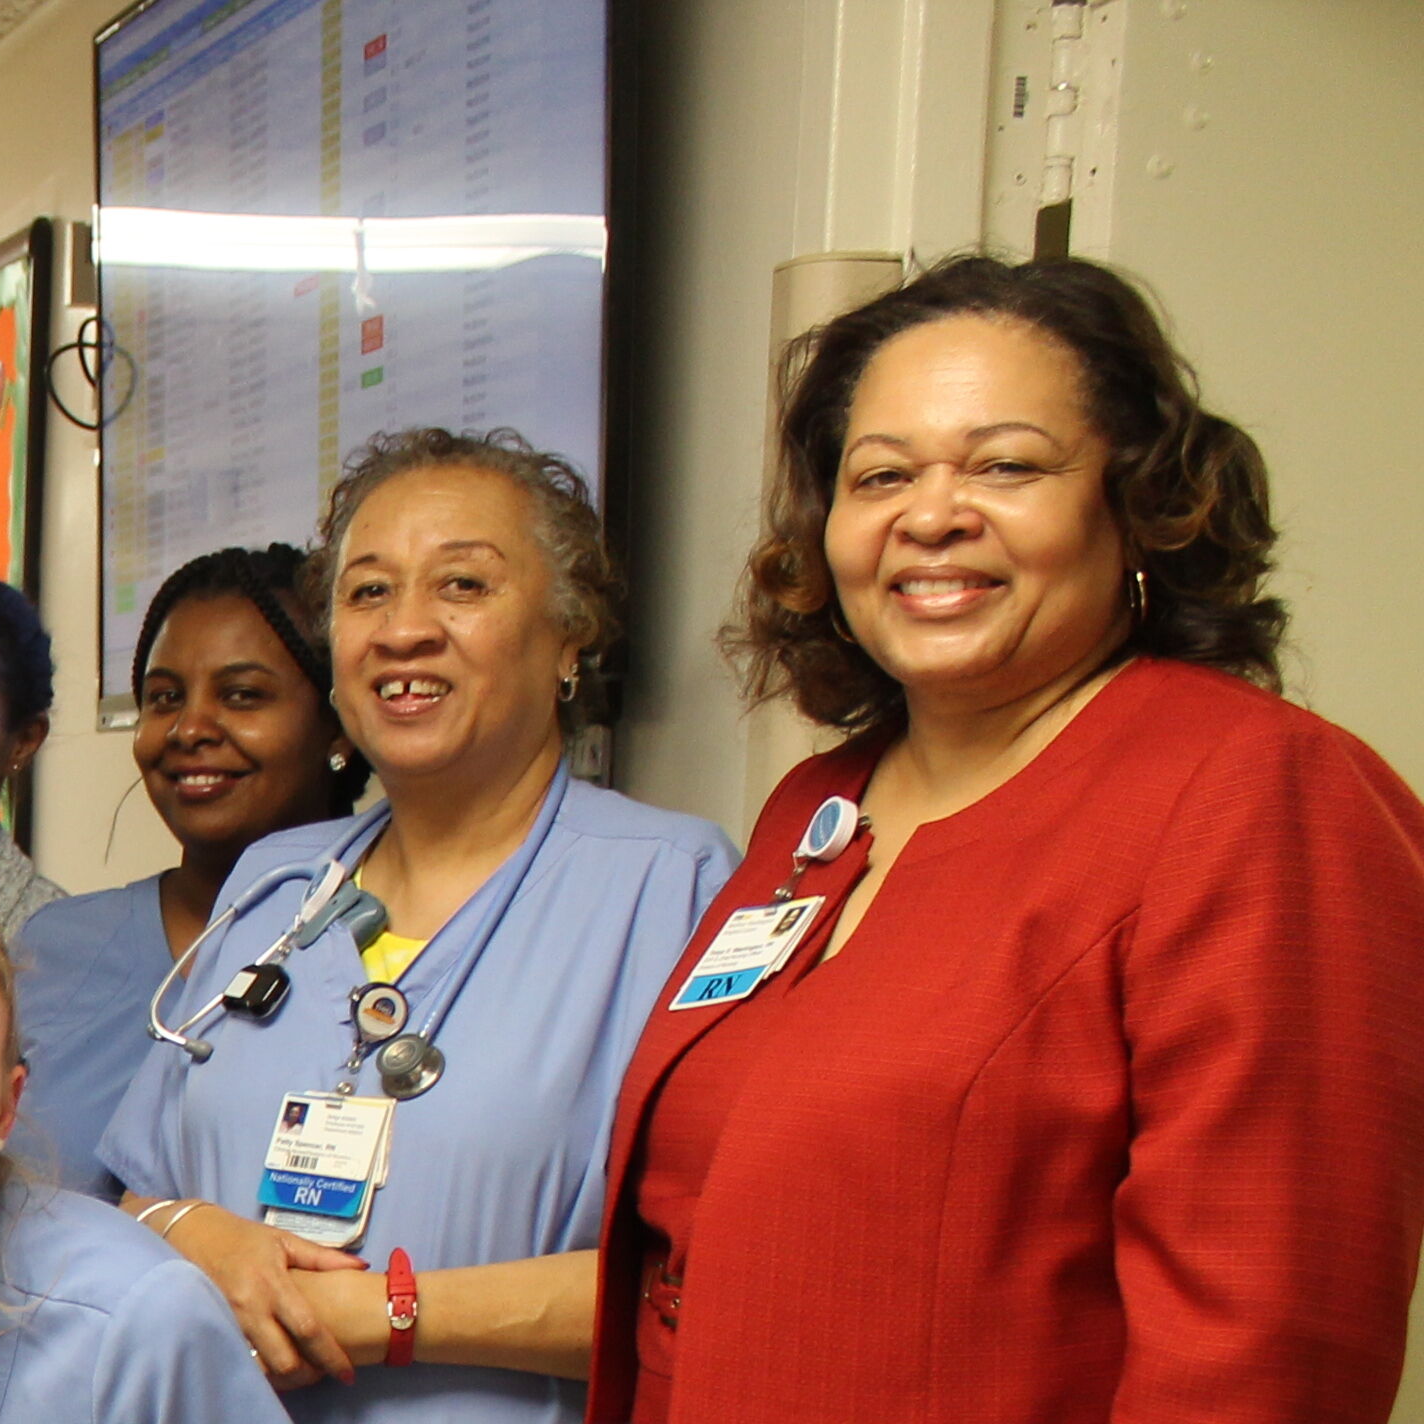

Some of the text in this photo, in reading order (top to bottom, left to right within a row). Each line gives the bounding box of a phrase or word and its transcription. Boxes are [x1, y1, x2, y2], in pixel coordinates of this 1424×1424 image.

[698, 975, 742, 1001] RN
[269, 1171, 356, 1193] Nationally Certified
[294, 1186, 321, 1206] RN
